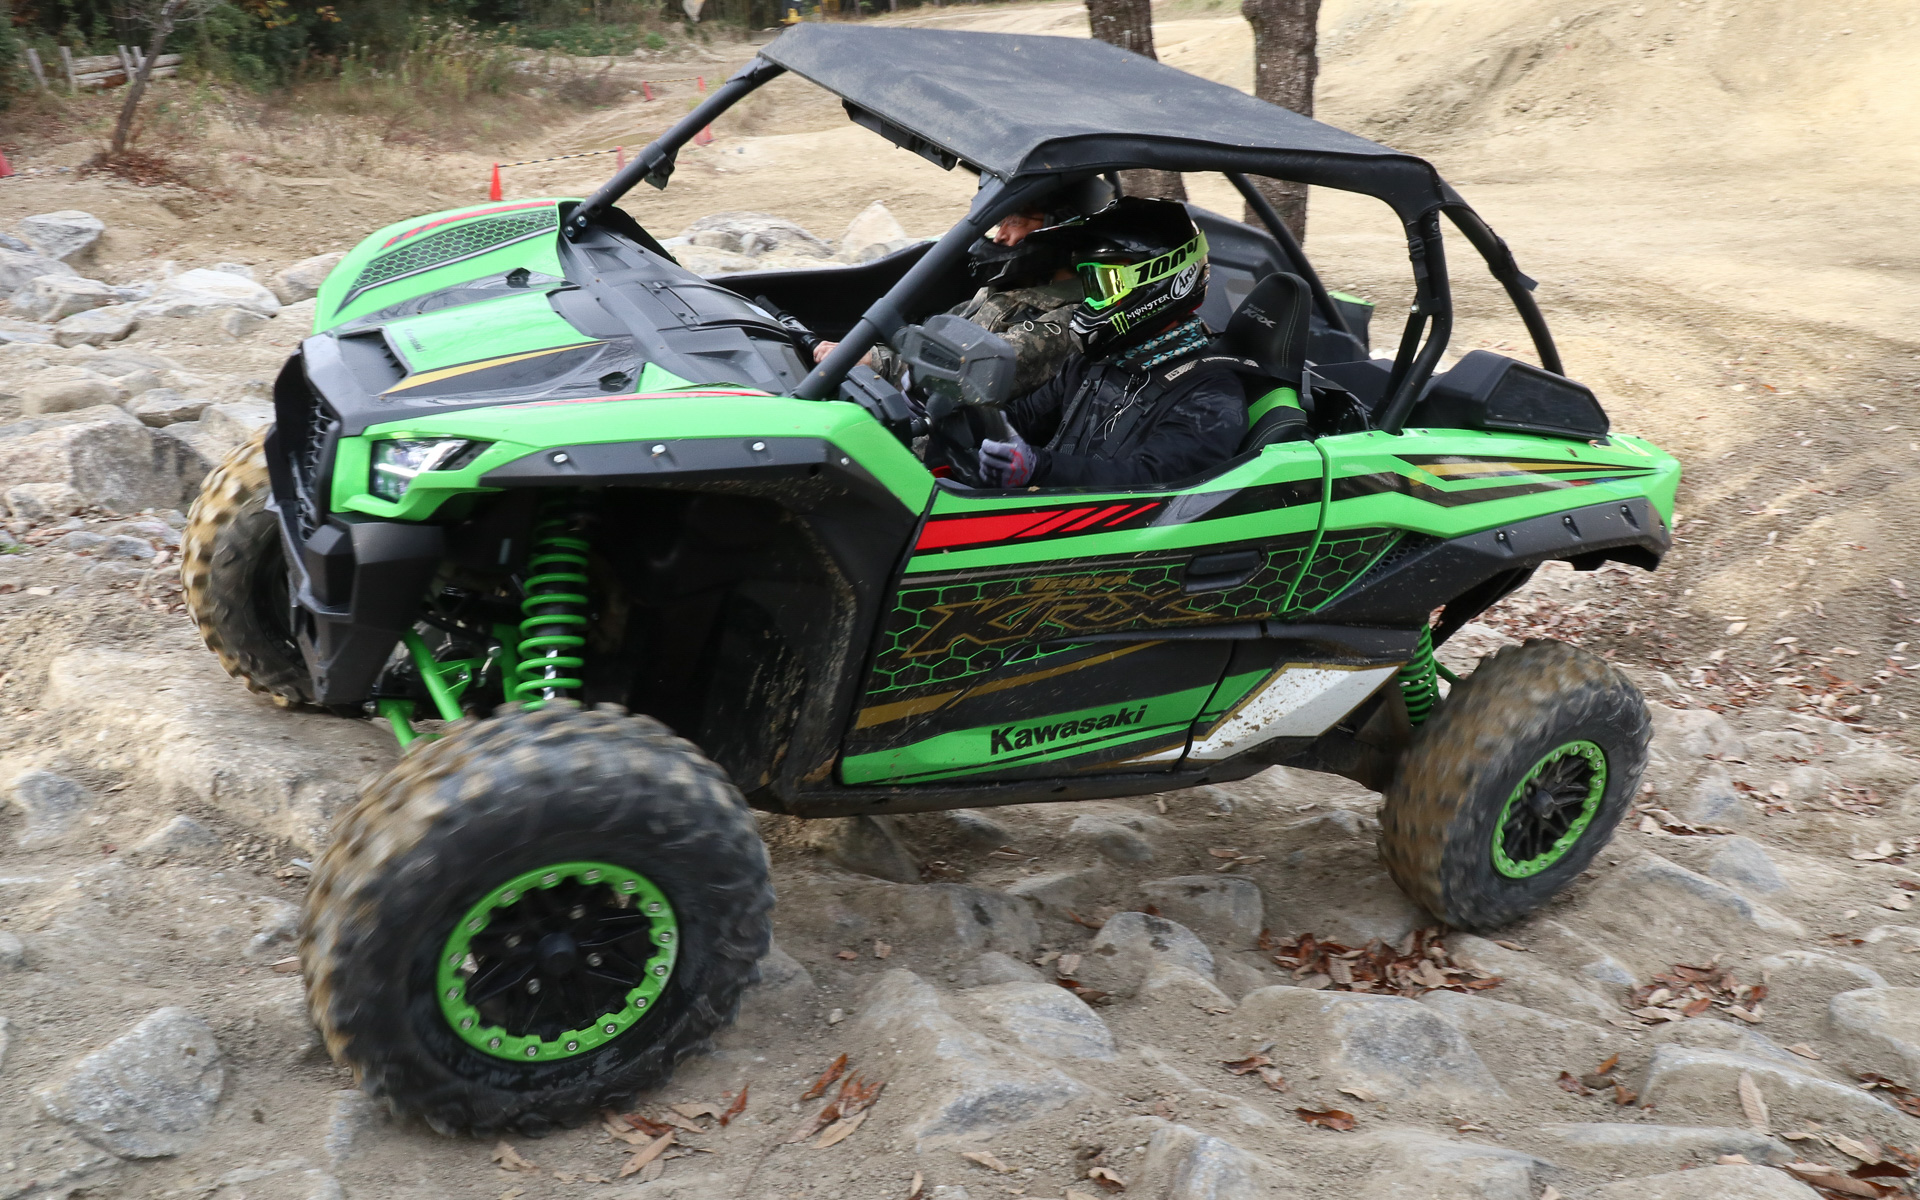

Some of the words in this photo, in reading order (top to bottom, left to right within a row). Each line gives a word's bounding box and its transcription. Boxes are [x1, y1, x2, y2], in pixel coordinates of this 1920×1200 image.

[1126, 294, 1170, 319] MONSTER
[1241, 308, 1277, 329] KRX
[900, 589, 1225, 659] KRX
[991, 704, 1148, 756] Kawasaki
